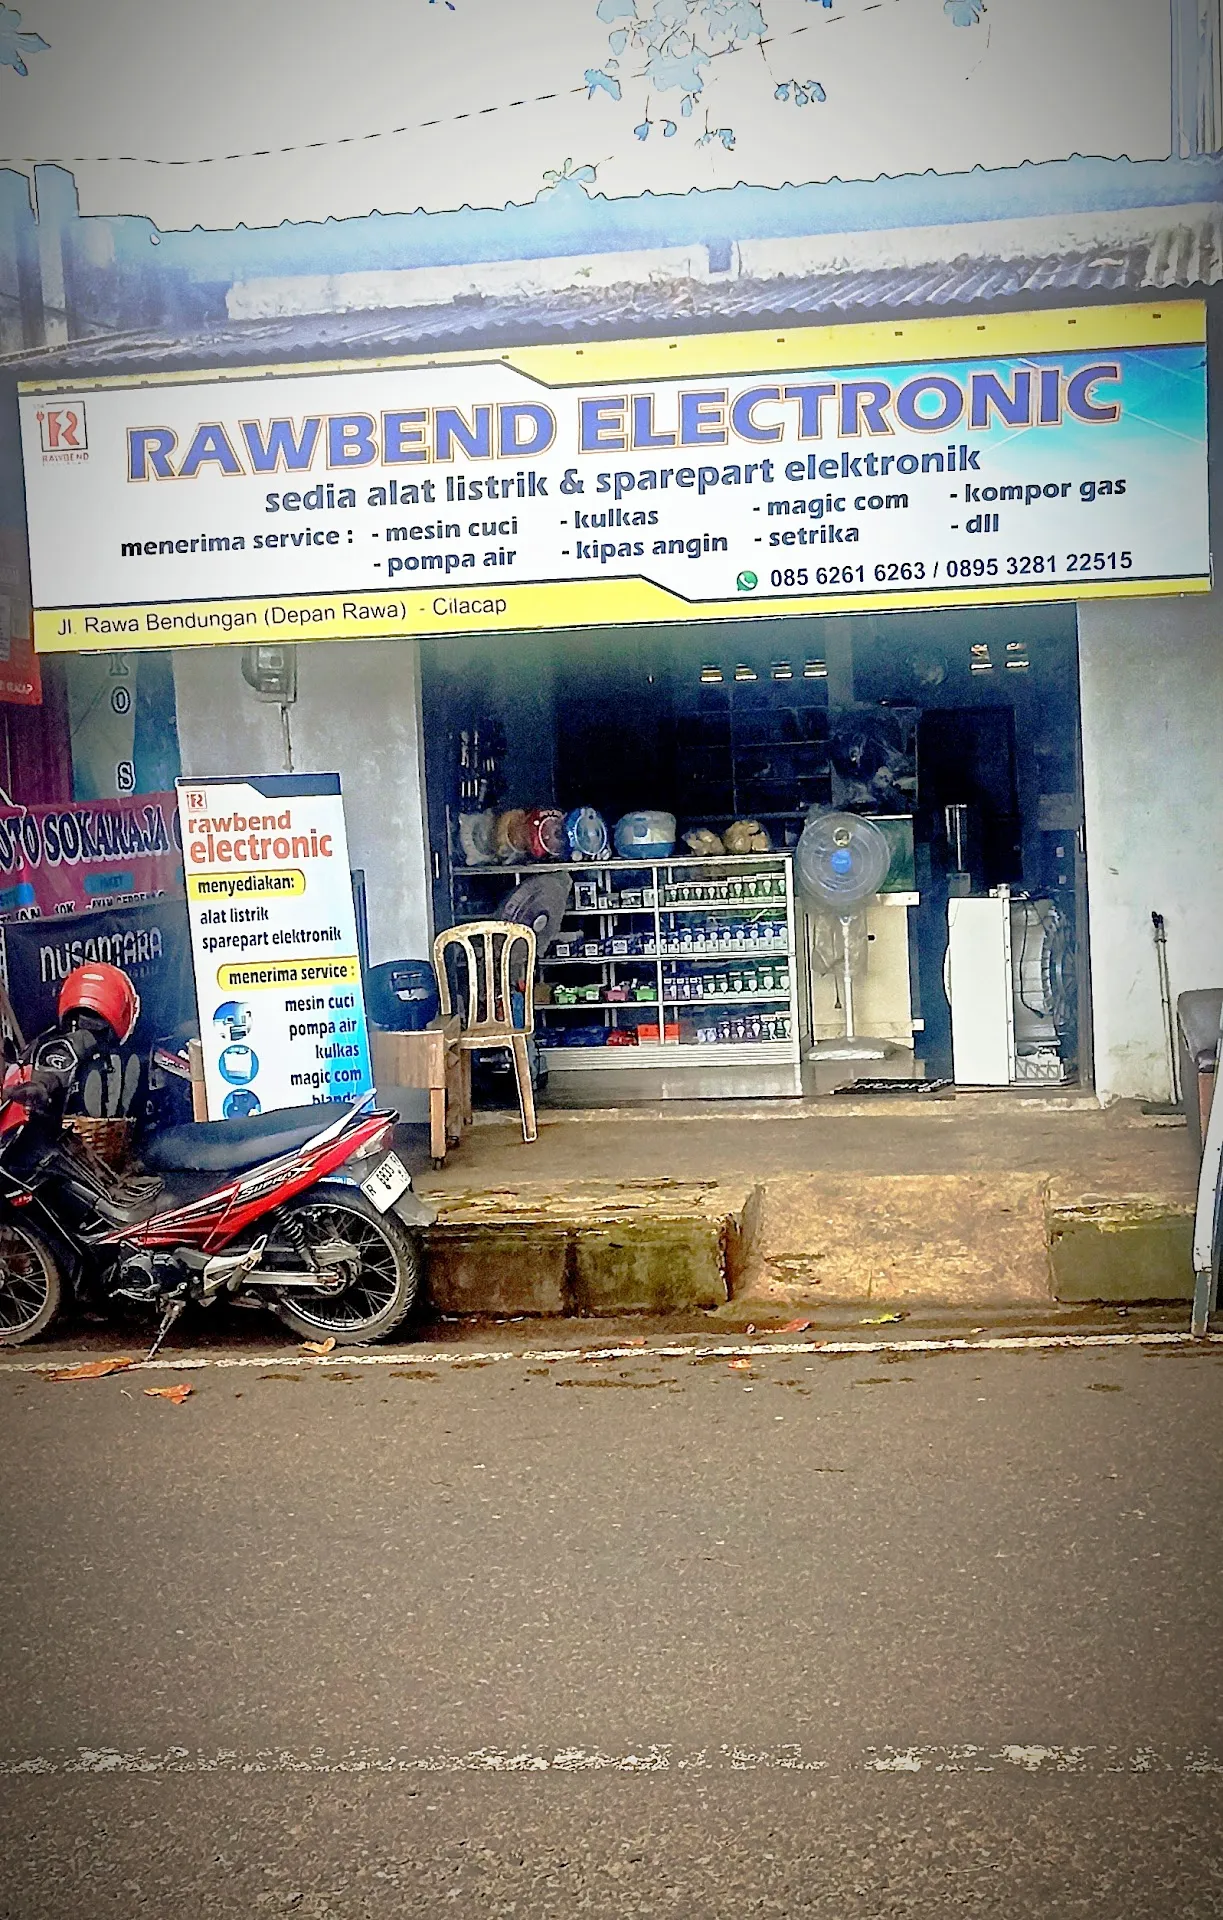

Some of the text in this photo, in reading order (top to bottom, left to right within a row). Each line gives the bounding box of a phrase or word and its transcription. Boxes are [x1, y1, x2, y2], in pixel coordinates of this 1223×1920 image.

[126, 363, 1122, 482] RAWBEND ELECTRONIC
[266, 445, 980, 512] sedia alat listrik & sparepart elektronik
[965, 482, 1071, 505] kompor
[1080, 479, 1126, 502] gas
[768, 493, 845, 519] magic
[855, 493, 908, 510] com
[386, 520, 460, 541] mesin
[468, 517, 518, 537] cuci
[575, 509, 658, 528] kulkas
[966, 514, 999, 533] dll
[121, 534, 245, 556] menerima
[253, 528, 340, 548] service
[769, 525, 859, 546] setrika
[576, 540, 644, 563] kipas
[652, 533, 728, 558] angin
[388, 552, 475, 577] pompa
[483, 547, 516, 567] air
[770, 568, 808, 587] 085
[816, 565, 864, 585] 6261
[874, 562, 925, 582] 6263
[947, 558, 998, 577] 0895
[1007, 555, 1056, 574] 3281
[1066, 551, 1132, 571] 22515
[58, 619, 77, 635] Jl.
[85, 617, 139, 633] Rawa
[147, 611, 257, 631] Bendungan
[265, 606, 335, 628] (Depan
[343, 601, 406, 620] Rawa)
[433, 597, 506, 615] Cilacap
[188, 810, 291, 833] rawbend
[190, 828, 332, 863] electronic
[198, 875, 295, 897] menyediakan:
[200, 907, 269, 924] alat listrik
[202, 927, 342, 953] sparepart elektronik
[229, 967, 297, 985] menerima
[301, 963, 347, 980] service
[285, 993, 354, 1012] mesin cuci
[289, 1017, 357, 1041] pompa air
[315, 1043, 359, 1059] kulkas
[291, 1068, 361, 1088] magic com
